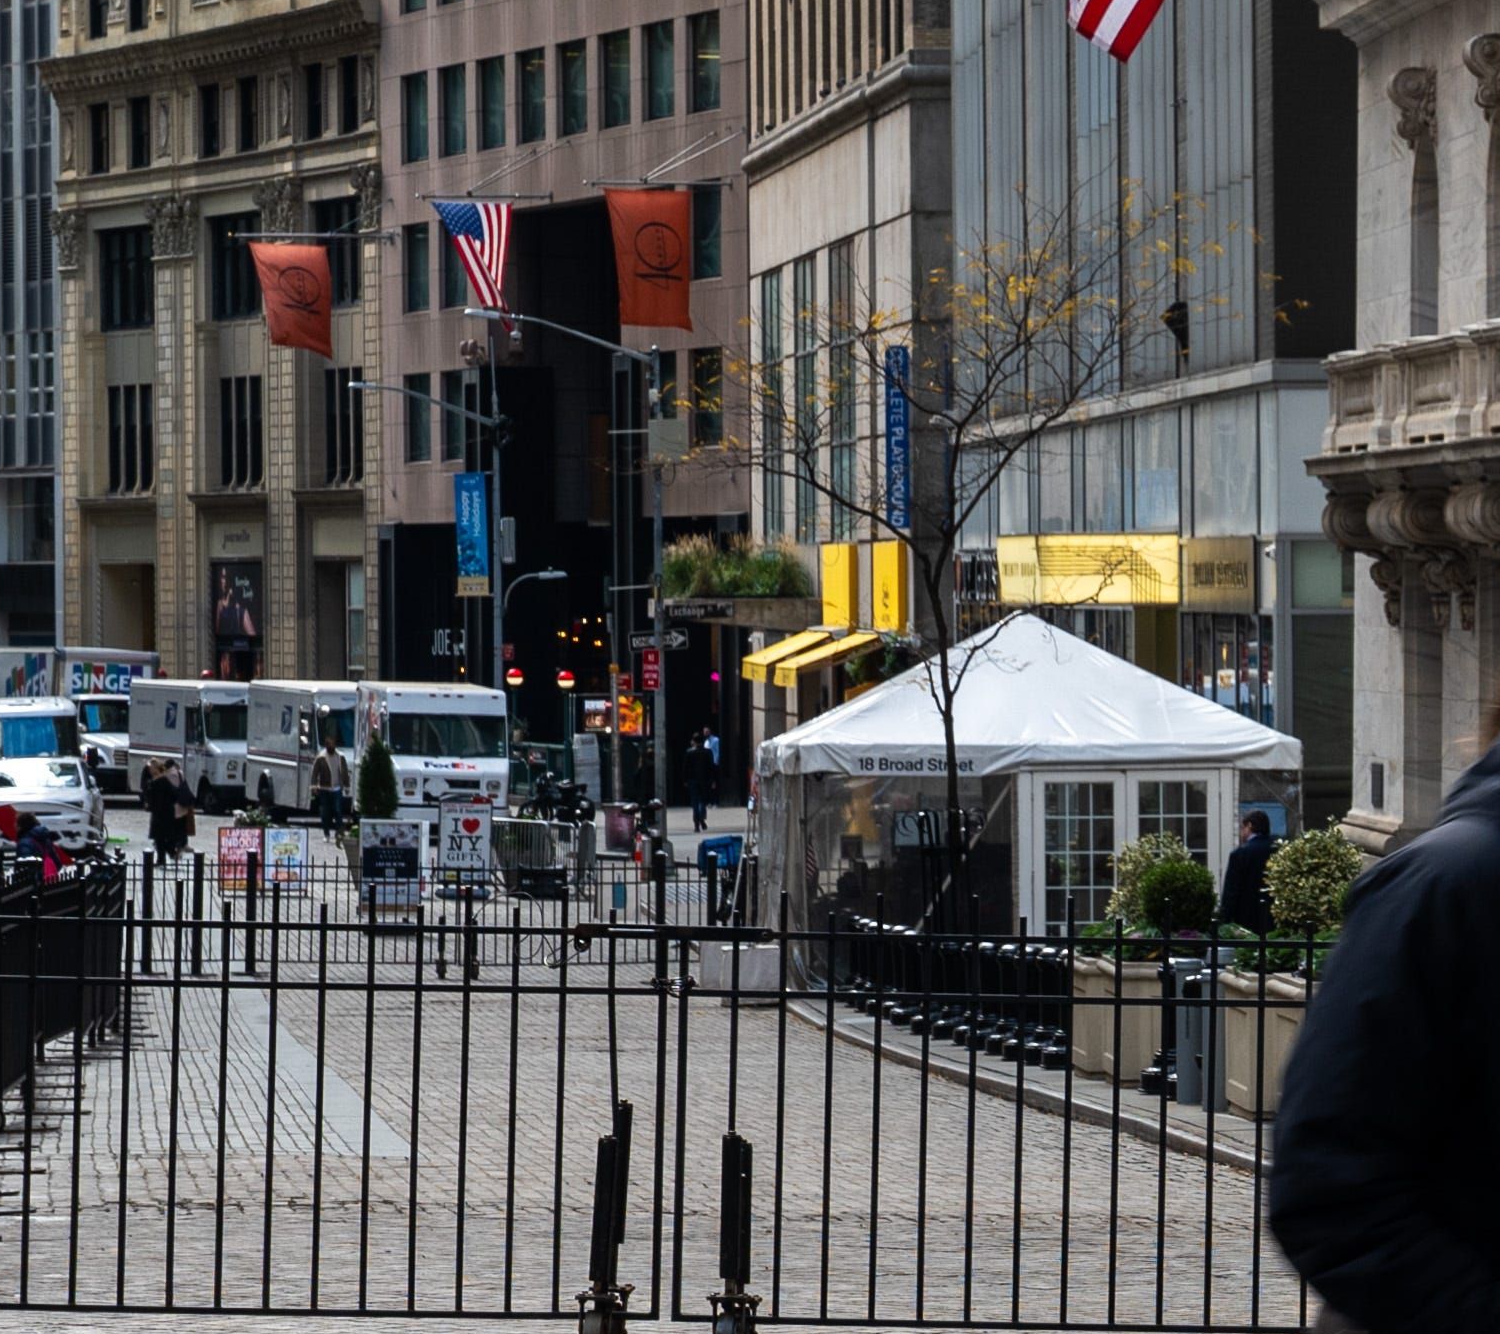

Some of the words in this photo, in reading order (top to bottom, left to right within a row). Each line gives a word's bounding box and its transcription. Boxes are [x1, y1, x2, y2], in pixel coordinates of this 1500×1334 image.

[71, 672, 138, 692] SINGE
[858, 757, 875, 772] 18
[878, 757, 924, 772] Broad
[927, 756, 974, 772] Stret
